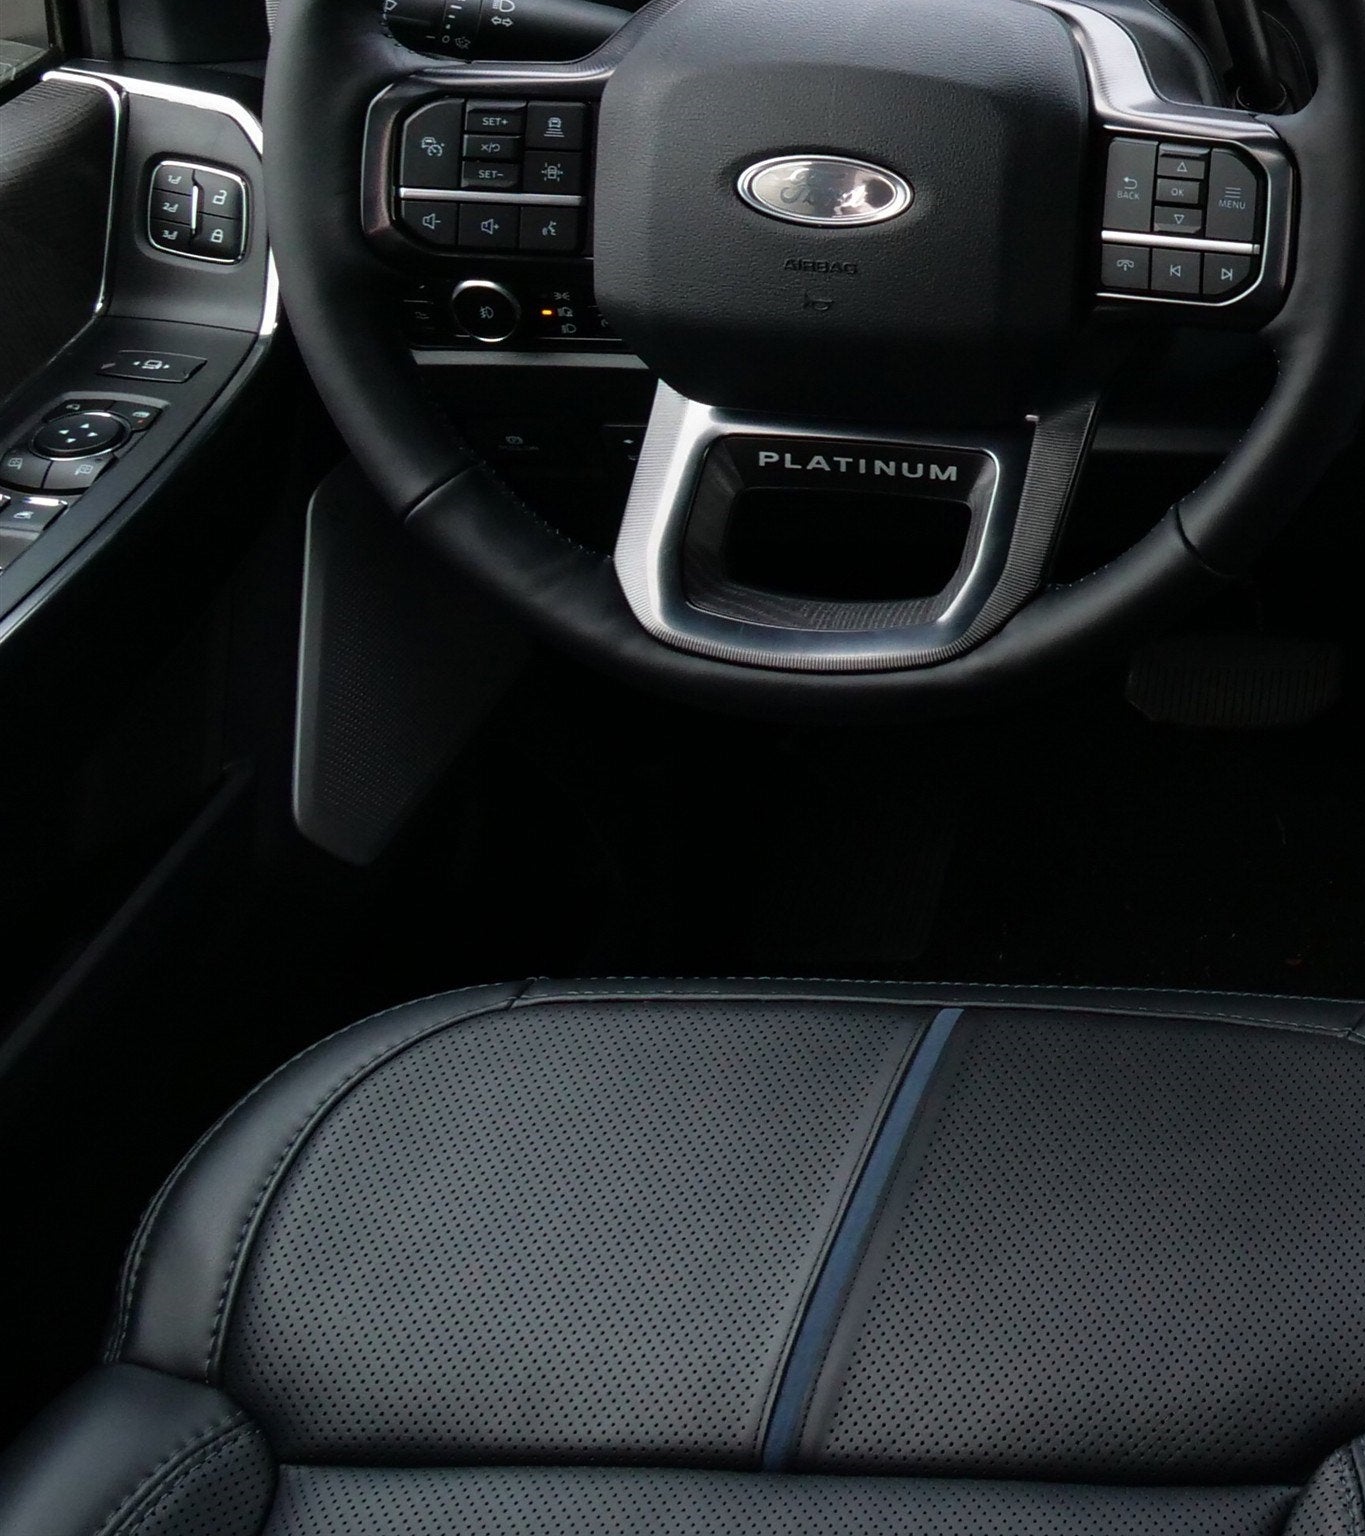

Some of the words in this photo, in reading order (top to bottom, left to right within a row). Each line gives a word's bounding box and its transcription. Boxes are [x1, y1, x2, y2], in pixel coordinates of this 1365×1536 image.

[482, 117, 509, 126] SET+
[1116, 191, 1140, 201] BACK
[1171, 187, 1185, 197] OK
[1219, 199, 1246, 210] MENU
[784, 258, 858, 275] AIRBAG
[757, 450, 959, 483] PLATINUM
